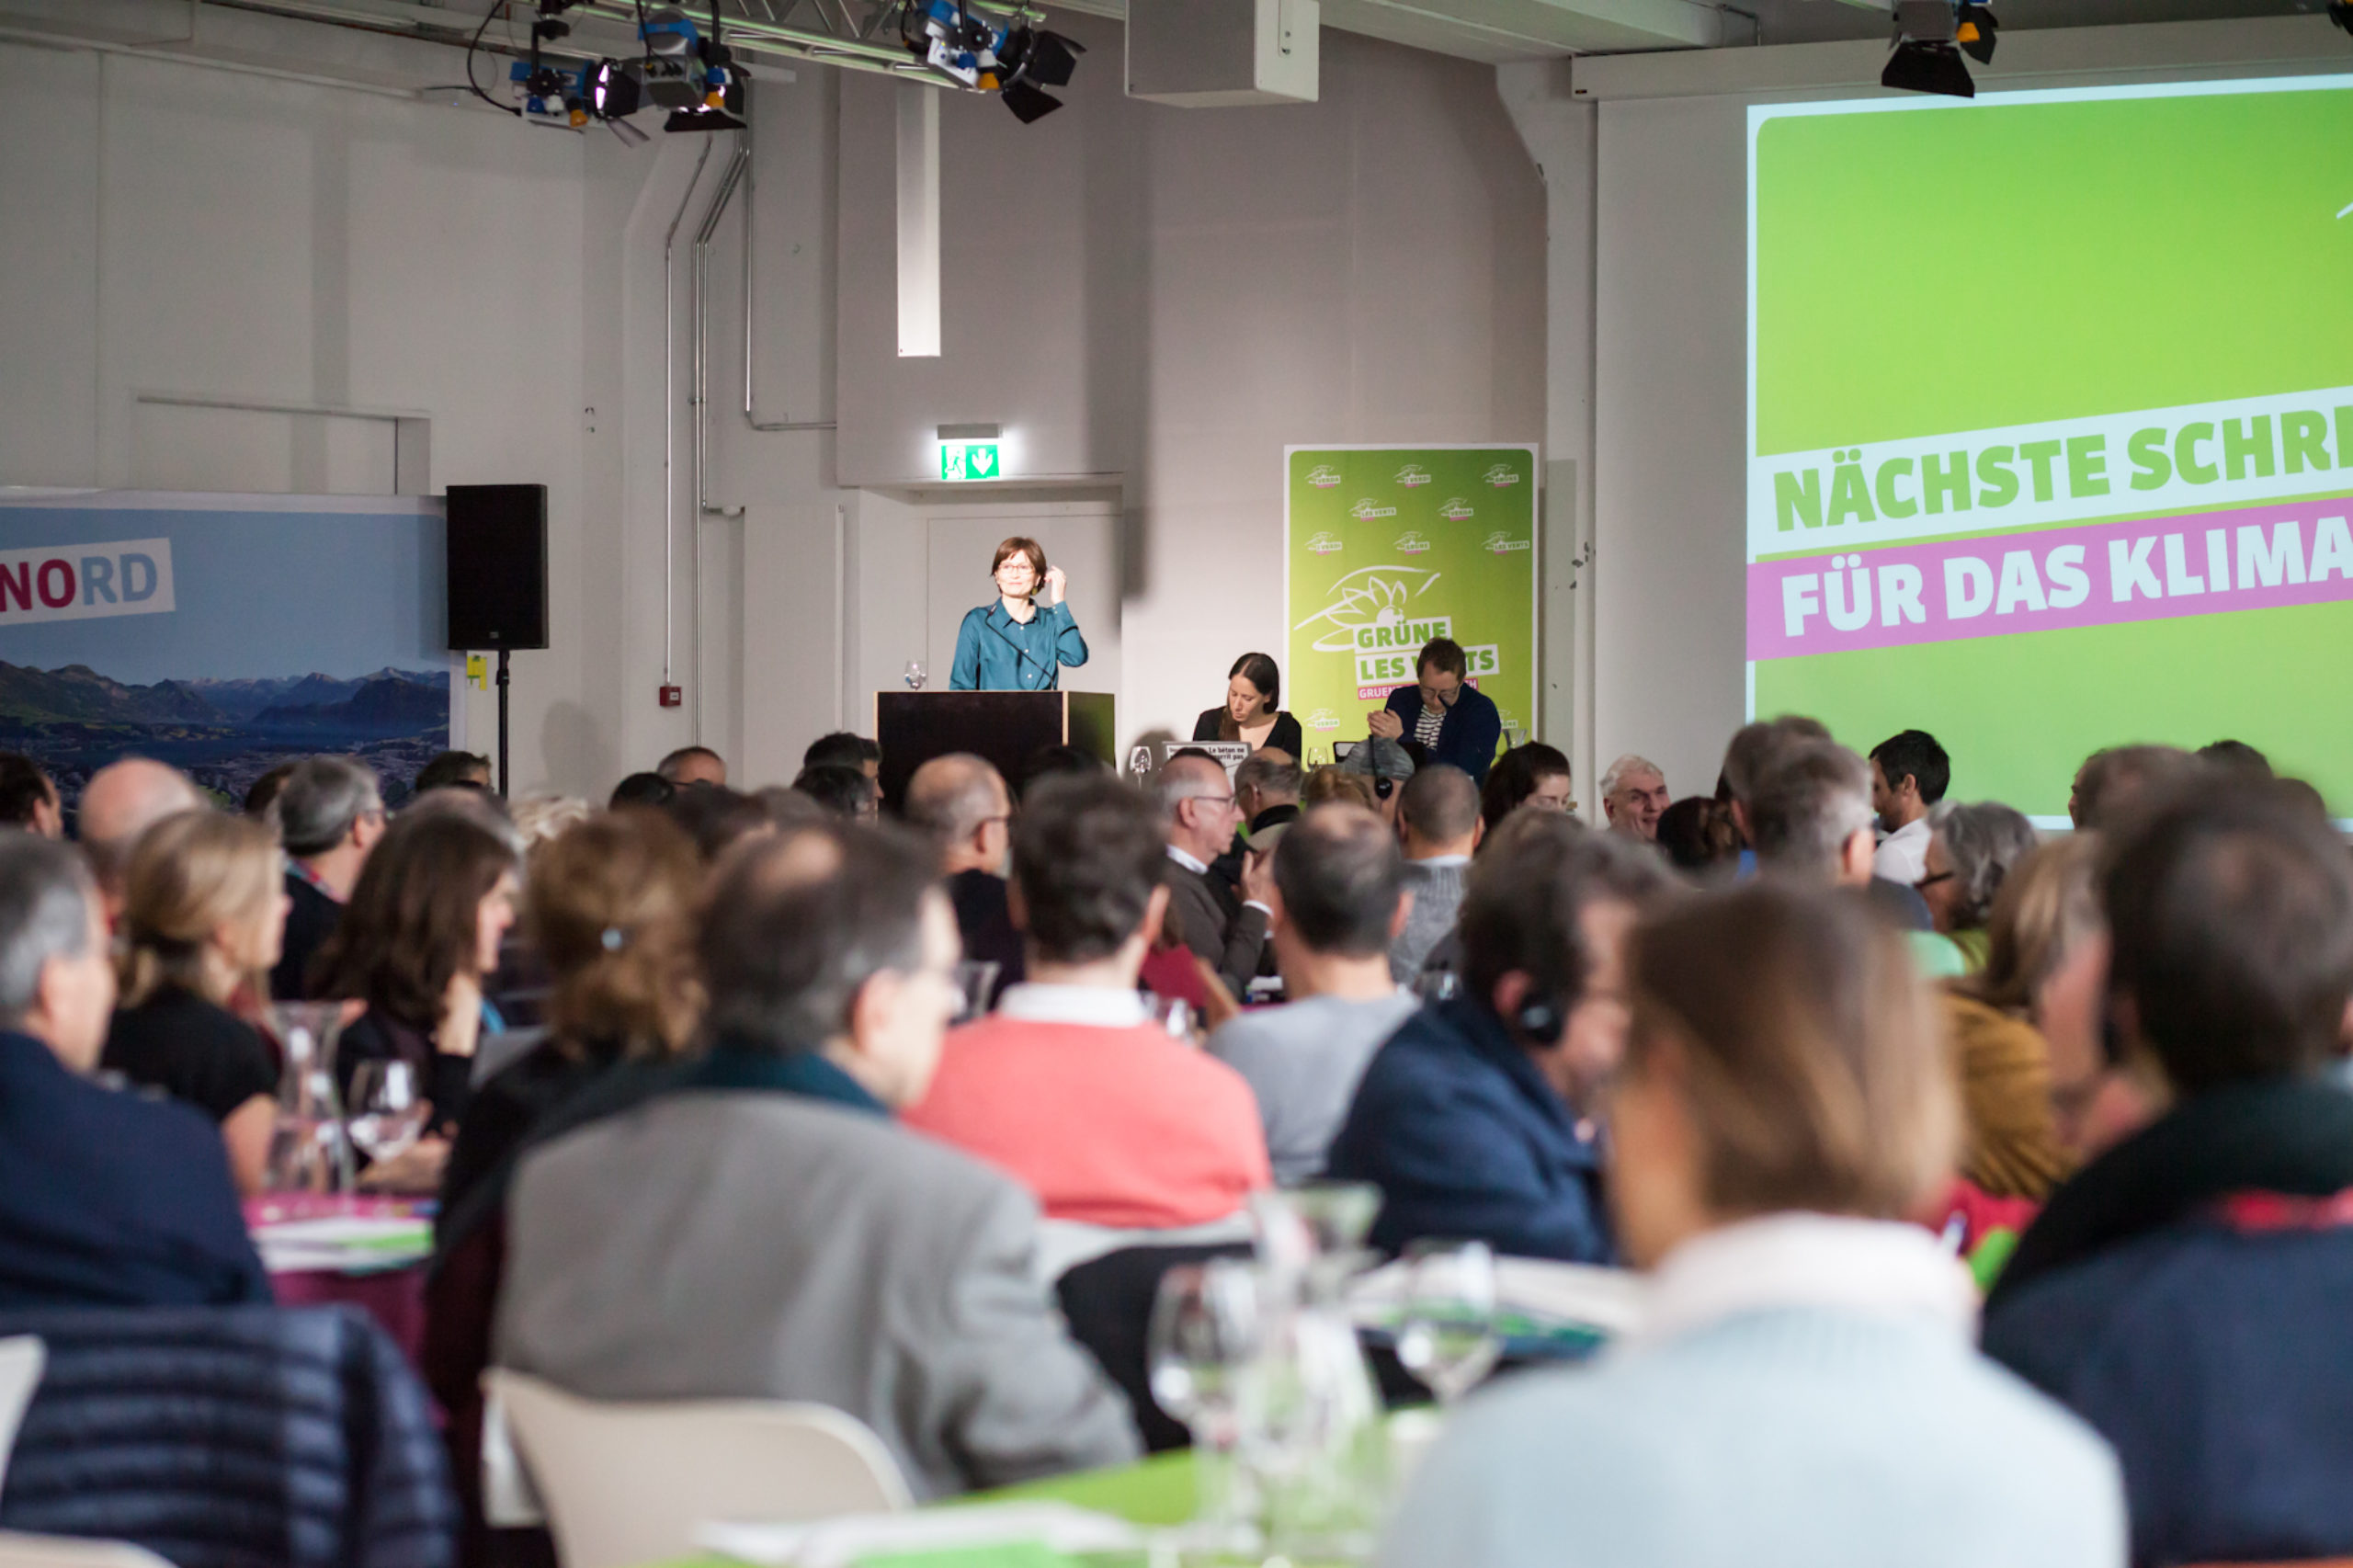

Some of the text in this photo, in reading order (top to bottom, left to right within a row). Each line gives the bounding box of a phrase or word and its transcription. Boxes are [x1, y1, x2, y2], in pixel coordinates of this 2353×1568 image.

[1773, 434, 2110, 532] NÄCHSTE
[0, 553, 157, 612] NORD
[1781, 516, 2353, 637] FÜR DAS KLIMA
[1358, 619, 1448, 648] GRÜNE
[1360, 657, 1405, 680] LES
